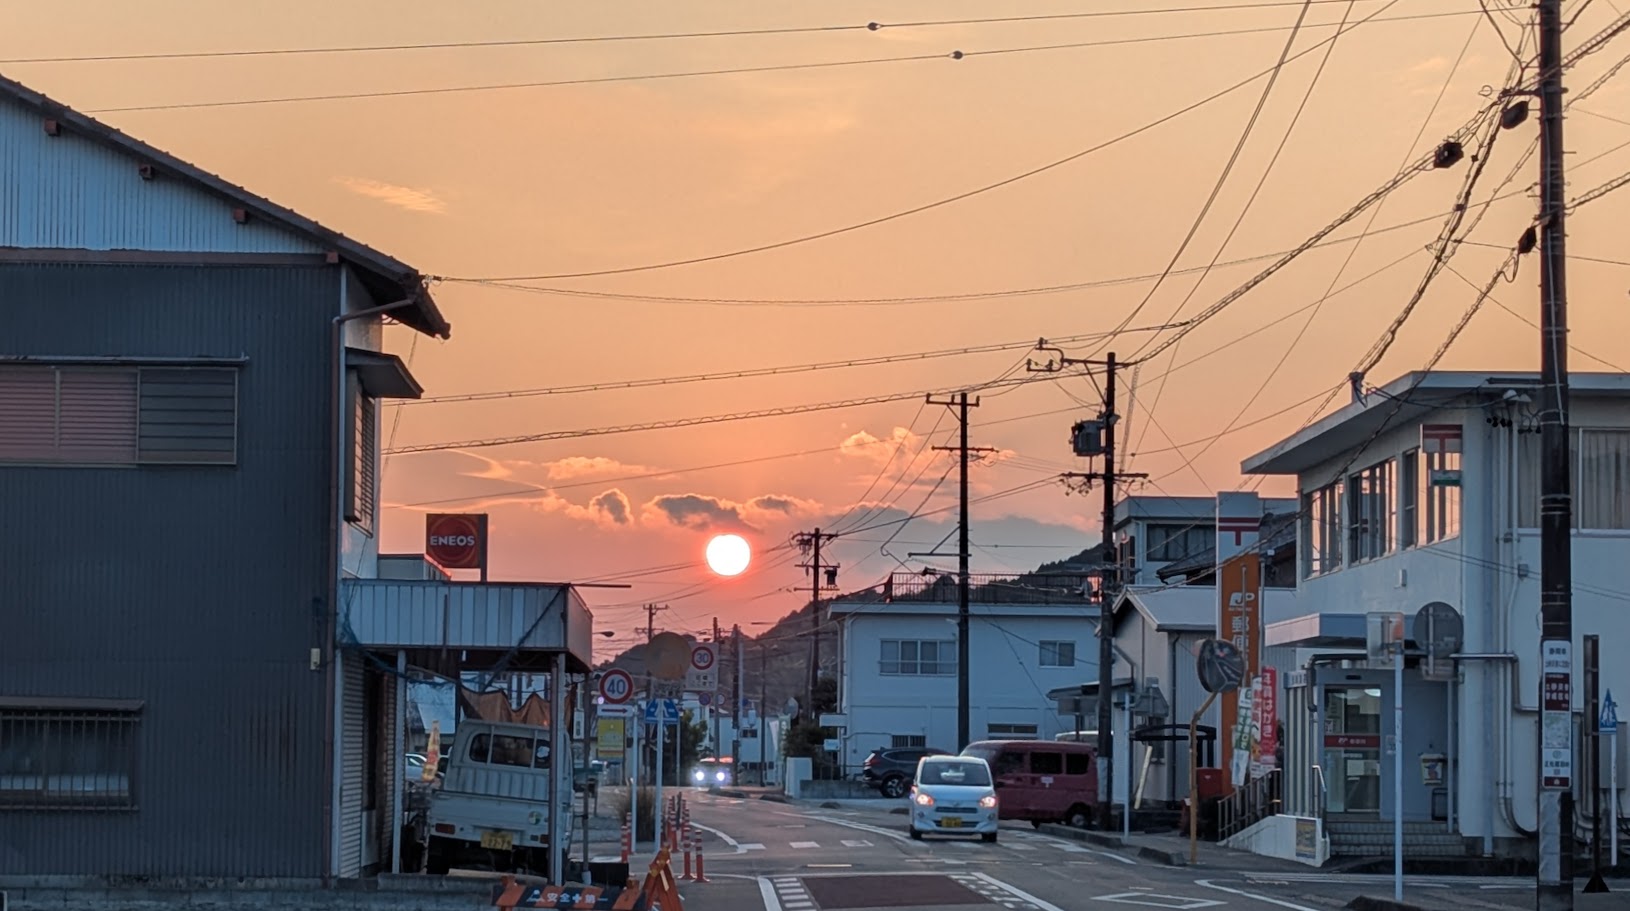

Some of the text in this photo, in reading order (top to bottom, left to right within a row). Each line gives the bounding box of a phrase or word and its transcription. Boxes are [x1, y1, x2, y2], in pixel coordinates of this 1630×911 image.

[430, 536, 475, 546] ENEOS
[696, 652, 709, 663] 30
[607, 679, 627, 695] 40
